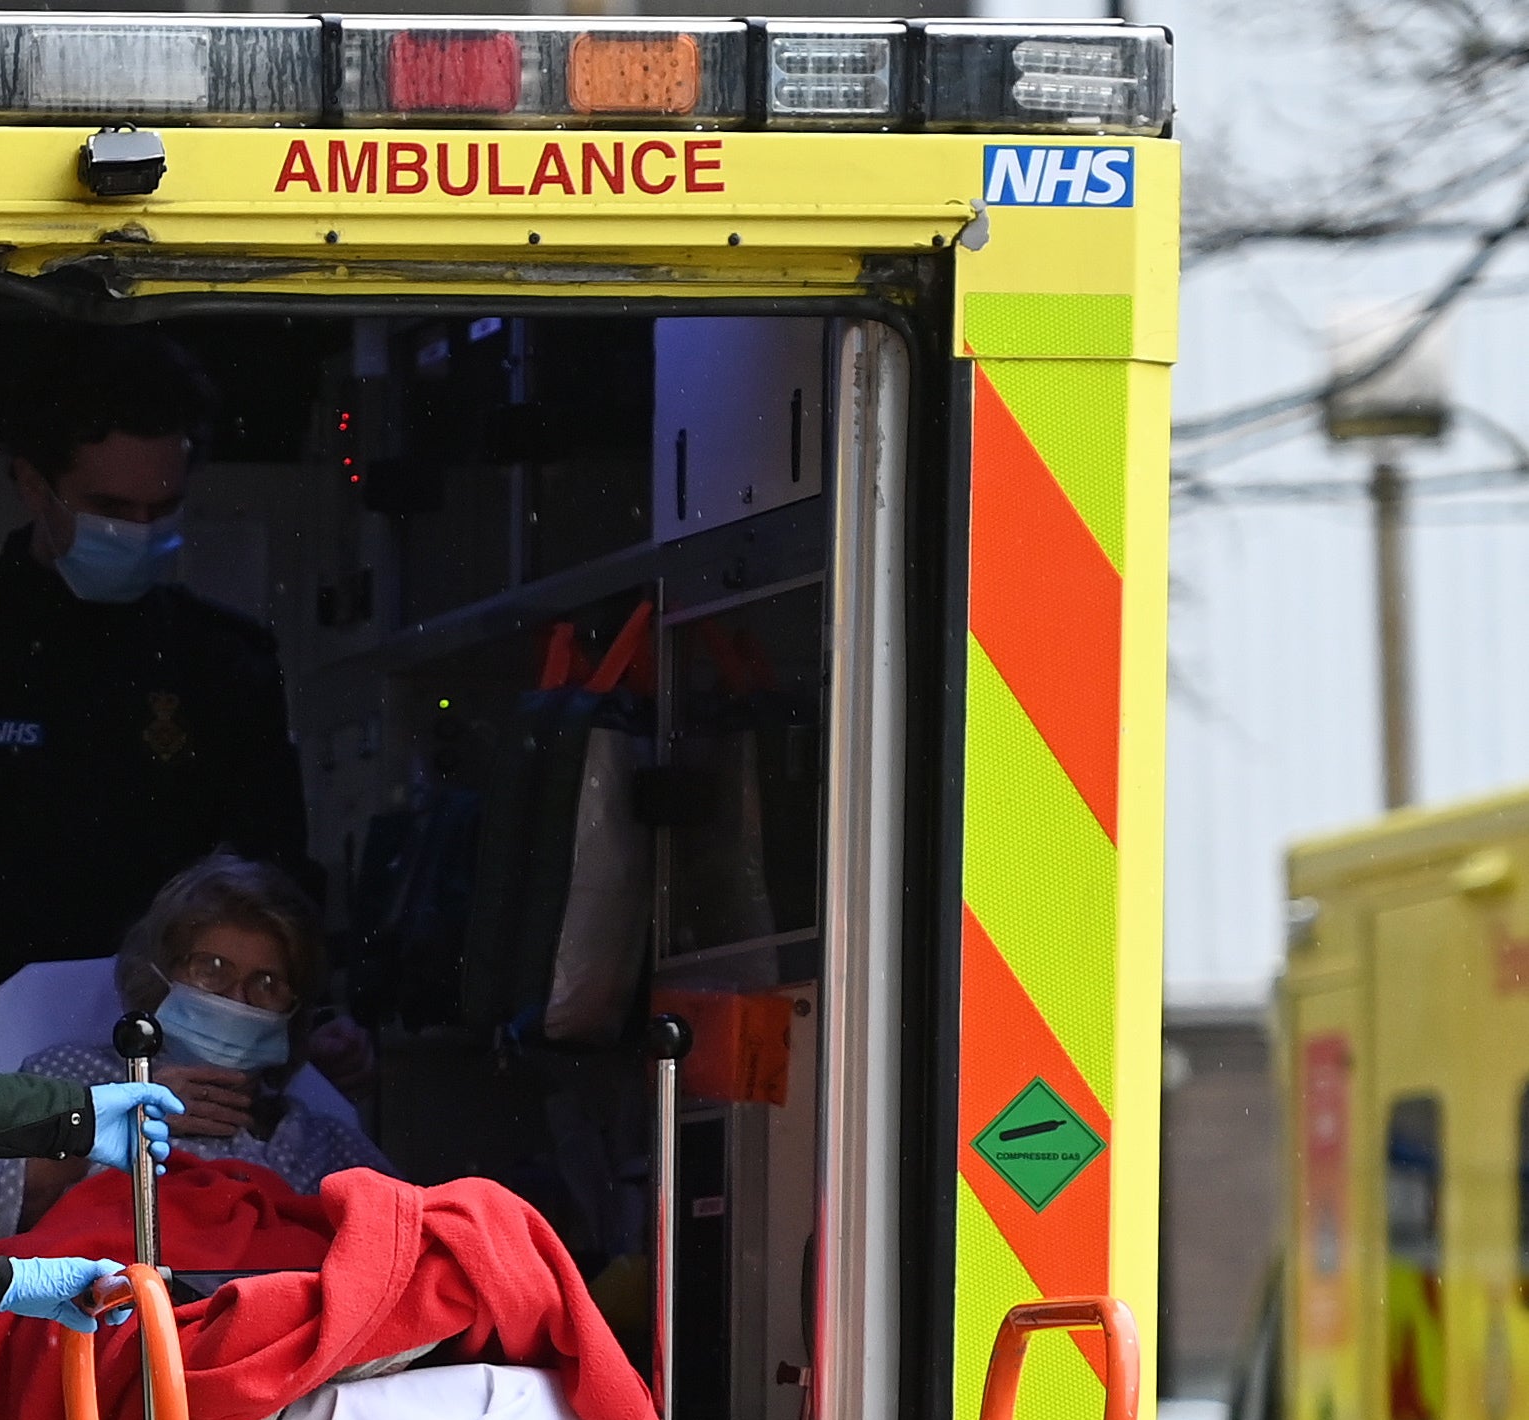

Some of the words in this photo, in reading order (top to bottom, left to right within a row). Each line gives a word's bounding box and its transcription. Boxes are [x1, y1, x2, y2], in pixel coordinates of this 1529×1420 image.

[274, 138, 726, 197] AMBULANCE
[985, 148, 1133, 206] NHS
[996, 1152, 1059, 1161] COMPRESSED
[1061, 1152, 1081, 1161] GAS
